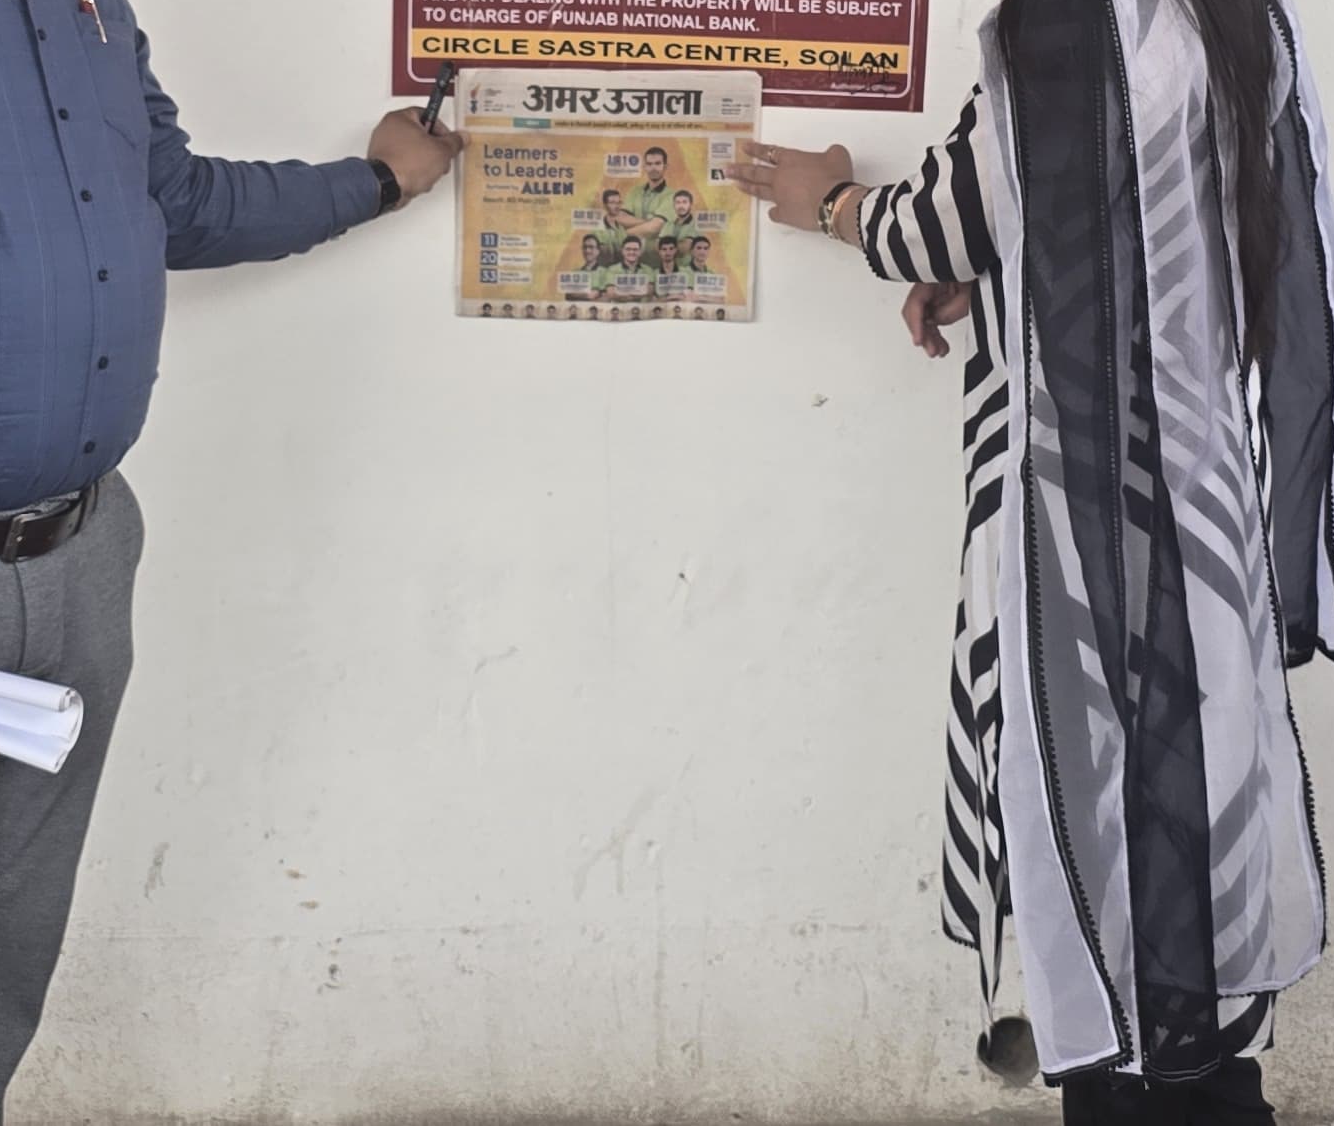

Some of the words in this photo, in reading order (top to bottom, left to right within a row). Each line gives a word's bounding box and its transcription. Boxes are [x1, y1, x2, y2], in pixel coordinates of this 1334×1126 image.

[798, 0, 821, 12] BE
[825, 0, 901, 16] SUBJECT
[423, 7, 445, 20] TO
[450, 8, 520, 22] CHARGE
[525, 9, 547, 23] OF
[552, 10, 618, 25] PUNJAB
[622, 12, 704, 28] NATIONAL
[709, 15, 759, 31] BANK.
[422, 37, 529, 55] CIRCLE
[538, 39, 655, 58] SASTRA
[664, 43, 789, 66] CENTRE,
[799, 49, 899, 68] SOLAN
[523, 85, 601, 114] अमर
[603, 88, 703, 115] उजाला
[484, 145, 558, 160] Learners
[483, 163, 501, 176] to
[506, 162, 574, 178] Leaders
[522, 181, 573, 196] ALLEN
